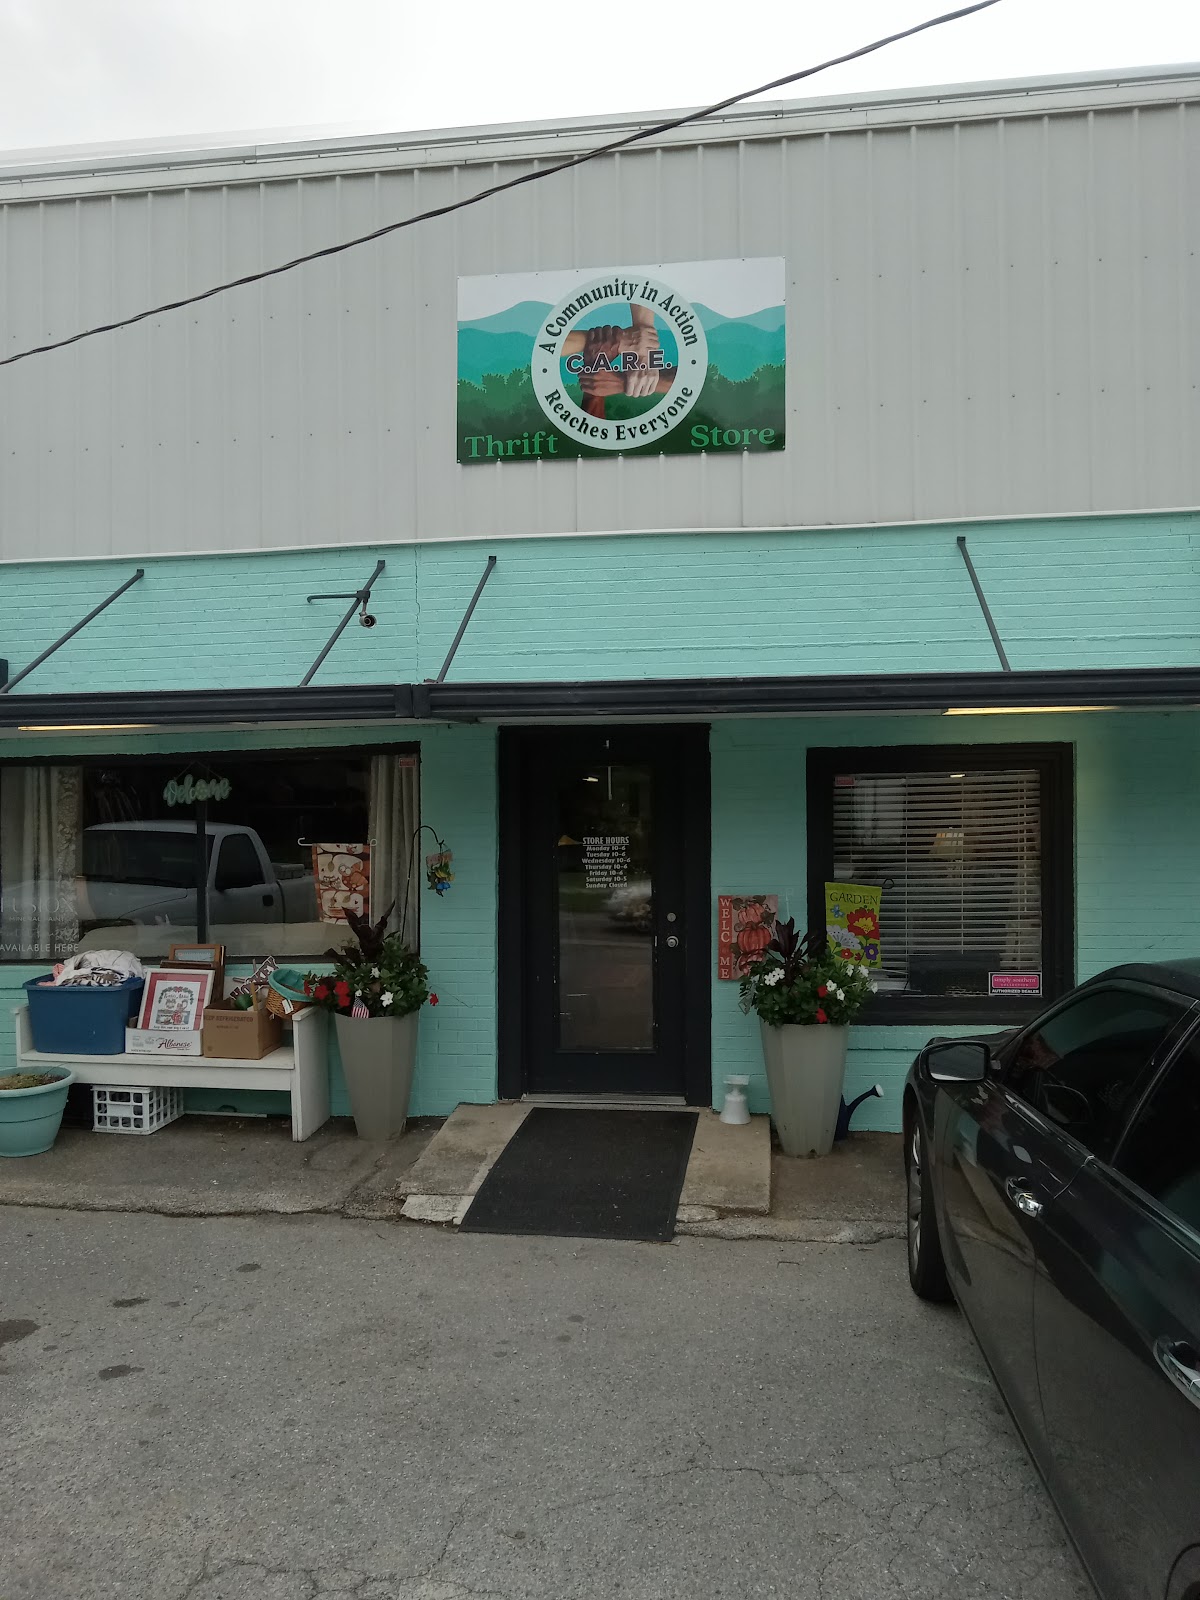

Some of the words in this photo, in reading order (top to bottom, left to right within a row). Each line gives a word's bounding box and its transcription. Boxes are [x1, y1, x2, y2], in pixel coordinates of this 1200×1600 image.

[640, 280, 659, 303] in
[545, 277, 639, 338] Community
[659, 294, 699, 347] Action
[538, 342, 557, 355] A
[565, 348, 673, 374] C.A.R.E.
[544, 388, 609, 440] Reaches
[615, 386, 693, 441] Everyone
[464, 430, 558, 458] Thrift
[690, 424, 776, 447] Store
[582, 836, 604, 845] STORE
[605, 836, 630, 845] HOURS
[829, 891, 879, 906] GARDEN
[0, 943, 51, 952] AVAILABLE
[54, 943, 80, 952] HERE
